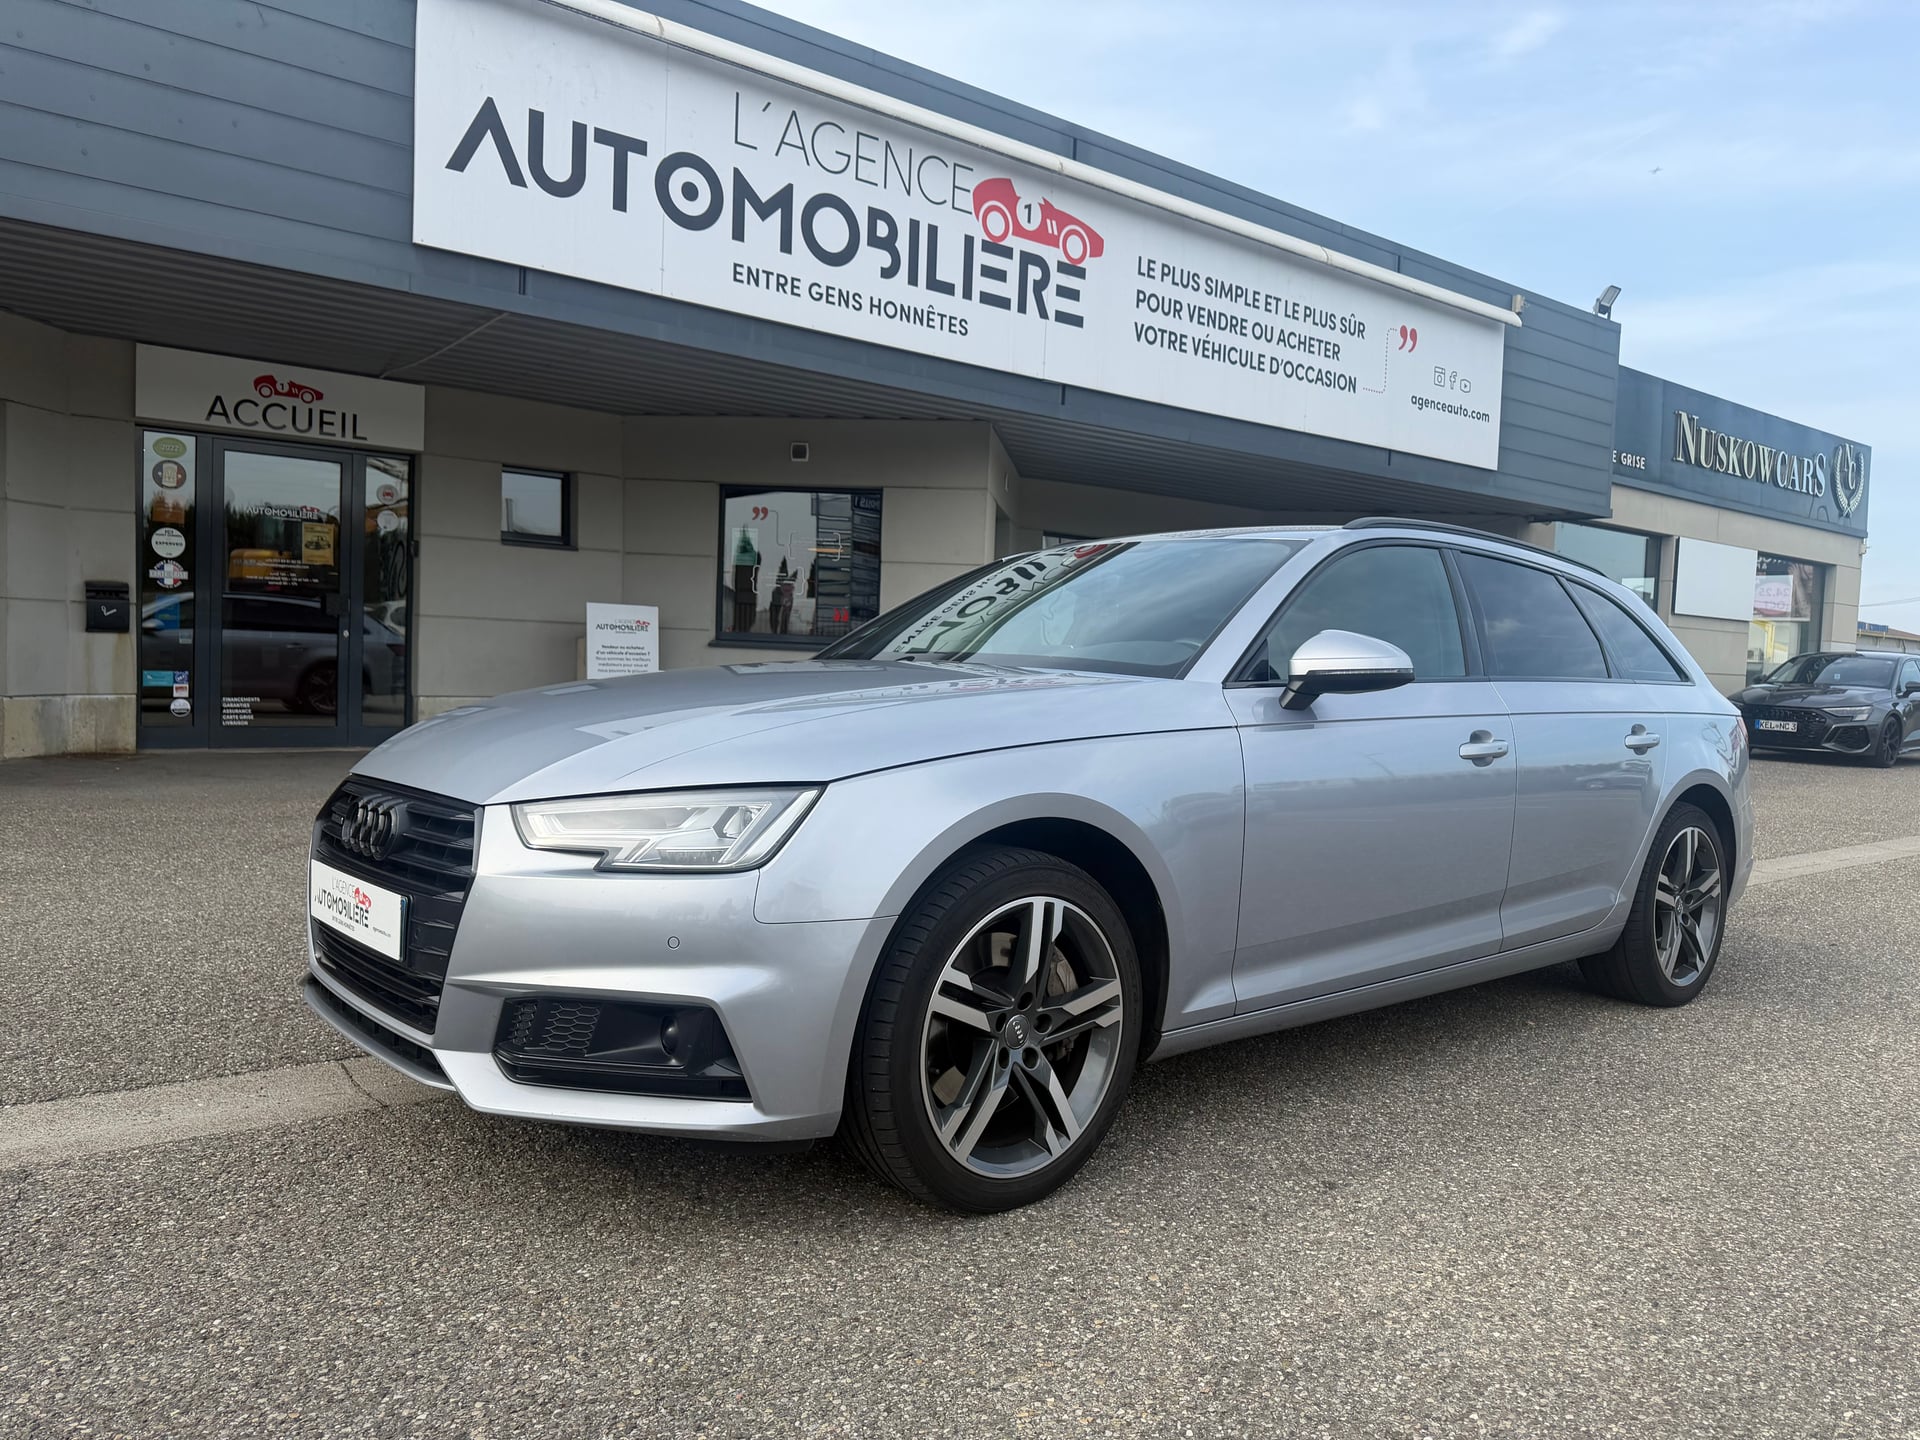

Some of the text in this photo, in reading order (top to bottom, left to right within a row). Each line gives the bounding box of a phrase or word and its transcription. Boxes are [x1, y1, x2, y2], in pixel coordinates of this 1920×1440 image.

[734, 91, 975, 215] L'AGENCE
[733, 264, 969, 337] ENTRE GENS HONNÊTES
[1136, 289, 1340, 361] POUR VENDRE OU ACHETER
[1137, 256, 1366, 340] LE PLUS SIMPLE ET LE PLUS SÛR
[1134, 321, 1357, 394] VOTRE VÉHICULE D'OCCASION
[205, 395, 368, 441] ACCUEIL
[1410, 393, 1490, 423] agenceauto.com
[1621, 452, 1646, 470] GRISE
[1759, 720, 1775, 729] KEL
